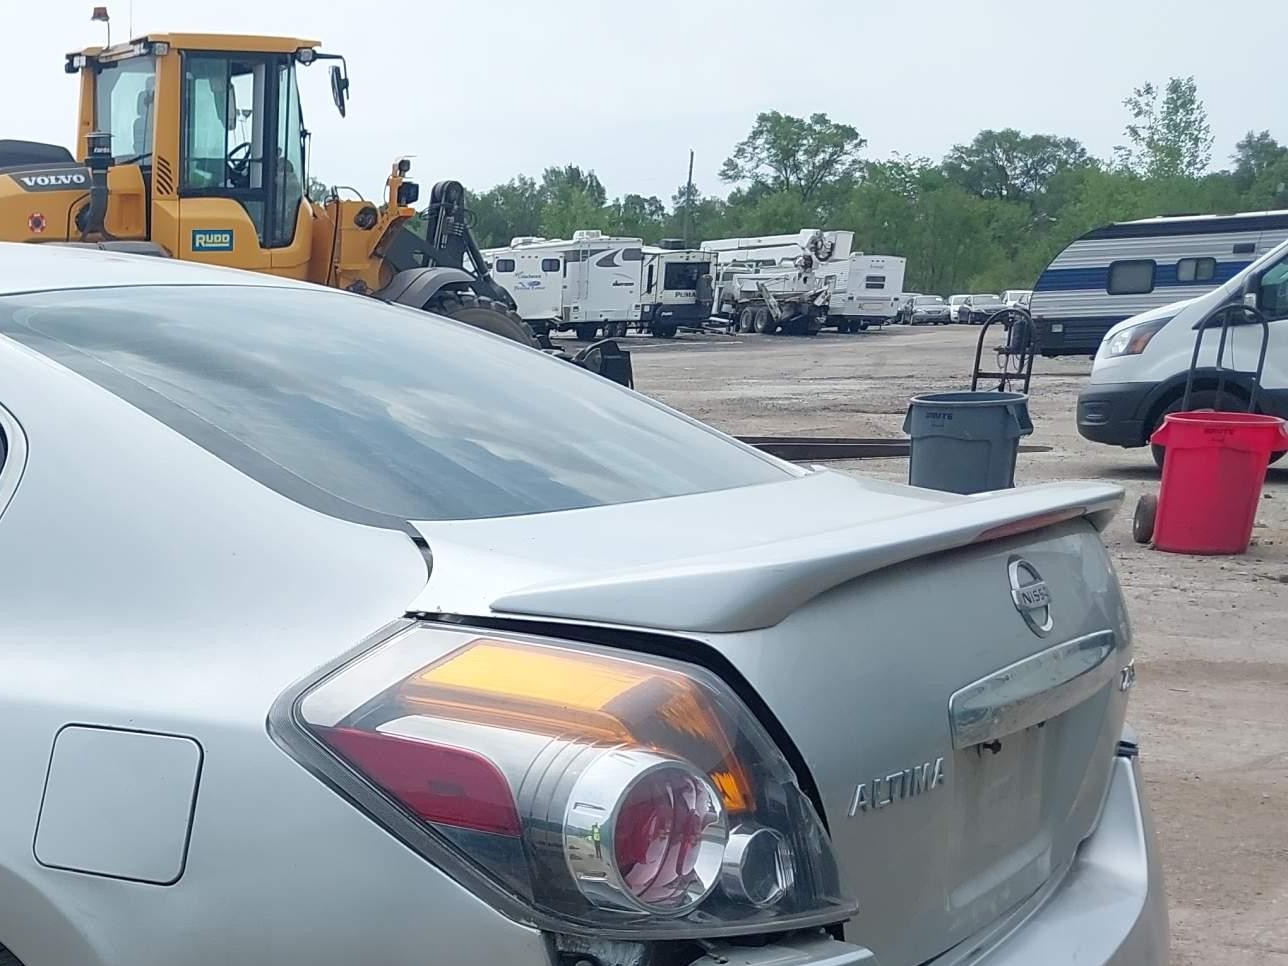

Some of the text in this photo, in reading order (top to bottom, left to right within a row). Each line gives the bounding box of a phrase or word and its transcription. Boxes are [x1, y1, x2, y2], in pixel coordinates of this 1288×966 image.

[20, 174, 85, 186] VOLVO
[195, 234, 230, 247] RUDD
[848, 757, 944, 817] ALTIMA
